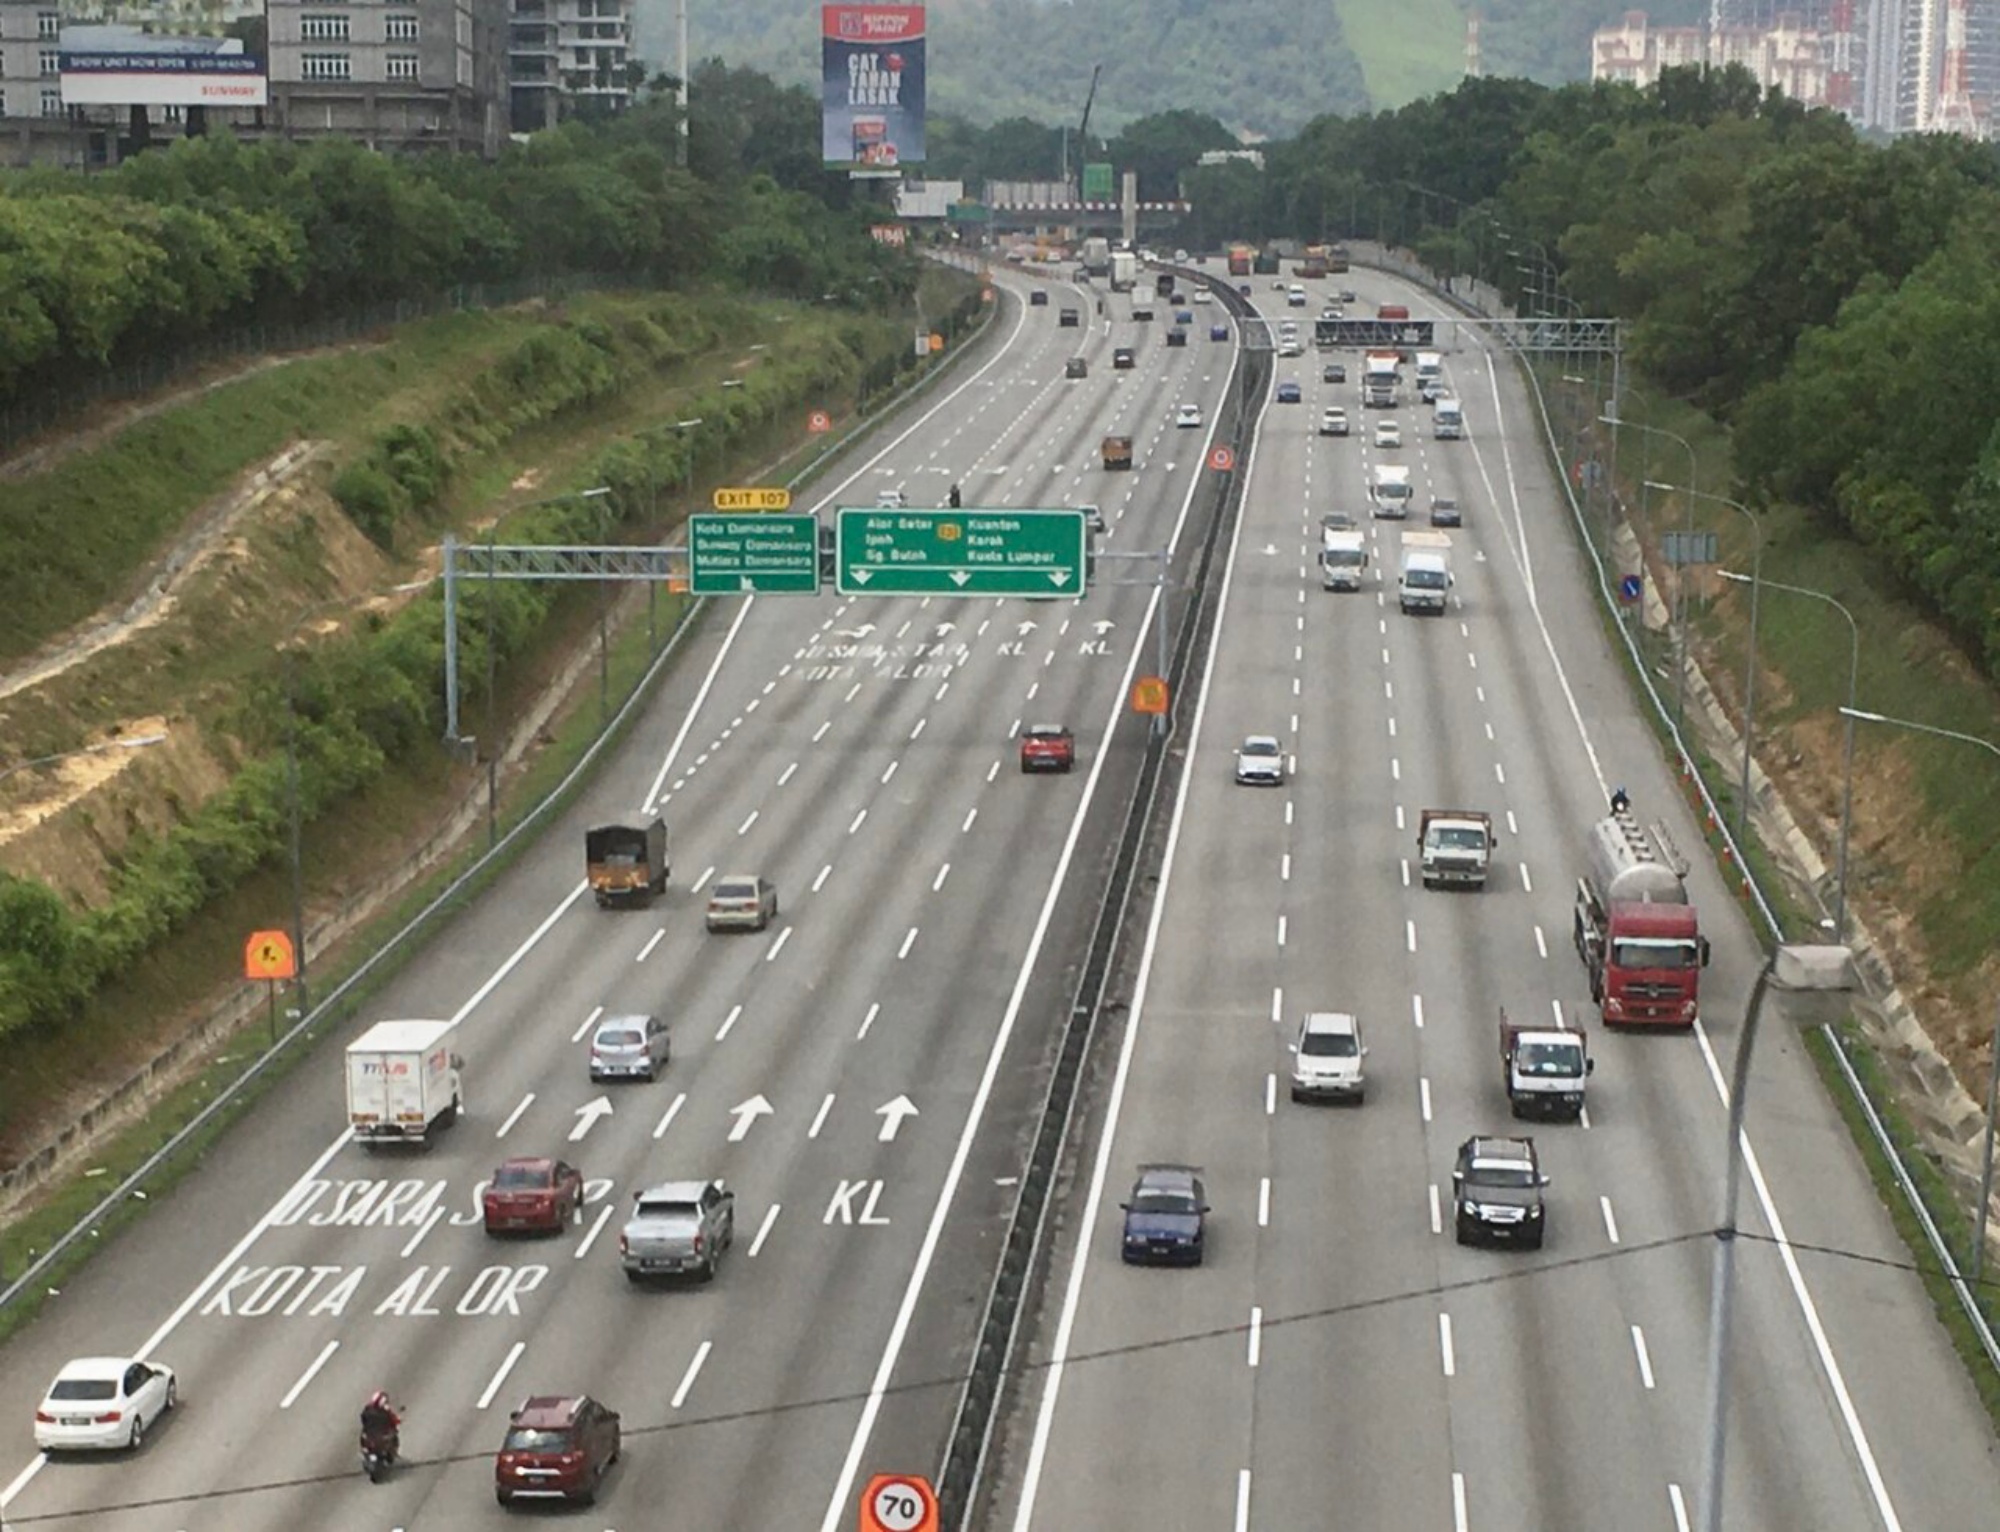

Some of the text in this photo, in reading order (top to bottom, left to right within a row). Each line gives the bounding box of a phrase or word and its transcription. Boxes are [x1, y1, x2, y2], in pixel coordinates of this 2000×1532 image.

[848, 53, 879, 71] CAT
[849, 70, 900, 88] TAHAN
[202, 85, 256, 97] SUNWAY
[848, 87, 899, 105] LASAK
[718, 493, 786, 506] EXIT 107
[696, 523, 795, 535] Kota Damansara
[866, 518, 893, 530] Alor
[967, 519, 1020, 532] Kuantan
[745, 539, 812, 552] Damansara
[866, 534, 894, 547] Ipoh
[967, 536, 1003, 547] Karak
[967, 551, 1056, 564] Kuala Lumpur
[997, 641, 1026, 656] KL
[1079, 640, 1113, 656] KL
[822, 1179, 891, 1225] KL
[201, 1265, 366, 1316] KOTA
[883, 1494, 916, 1519] 70
